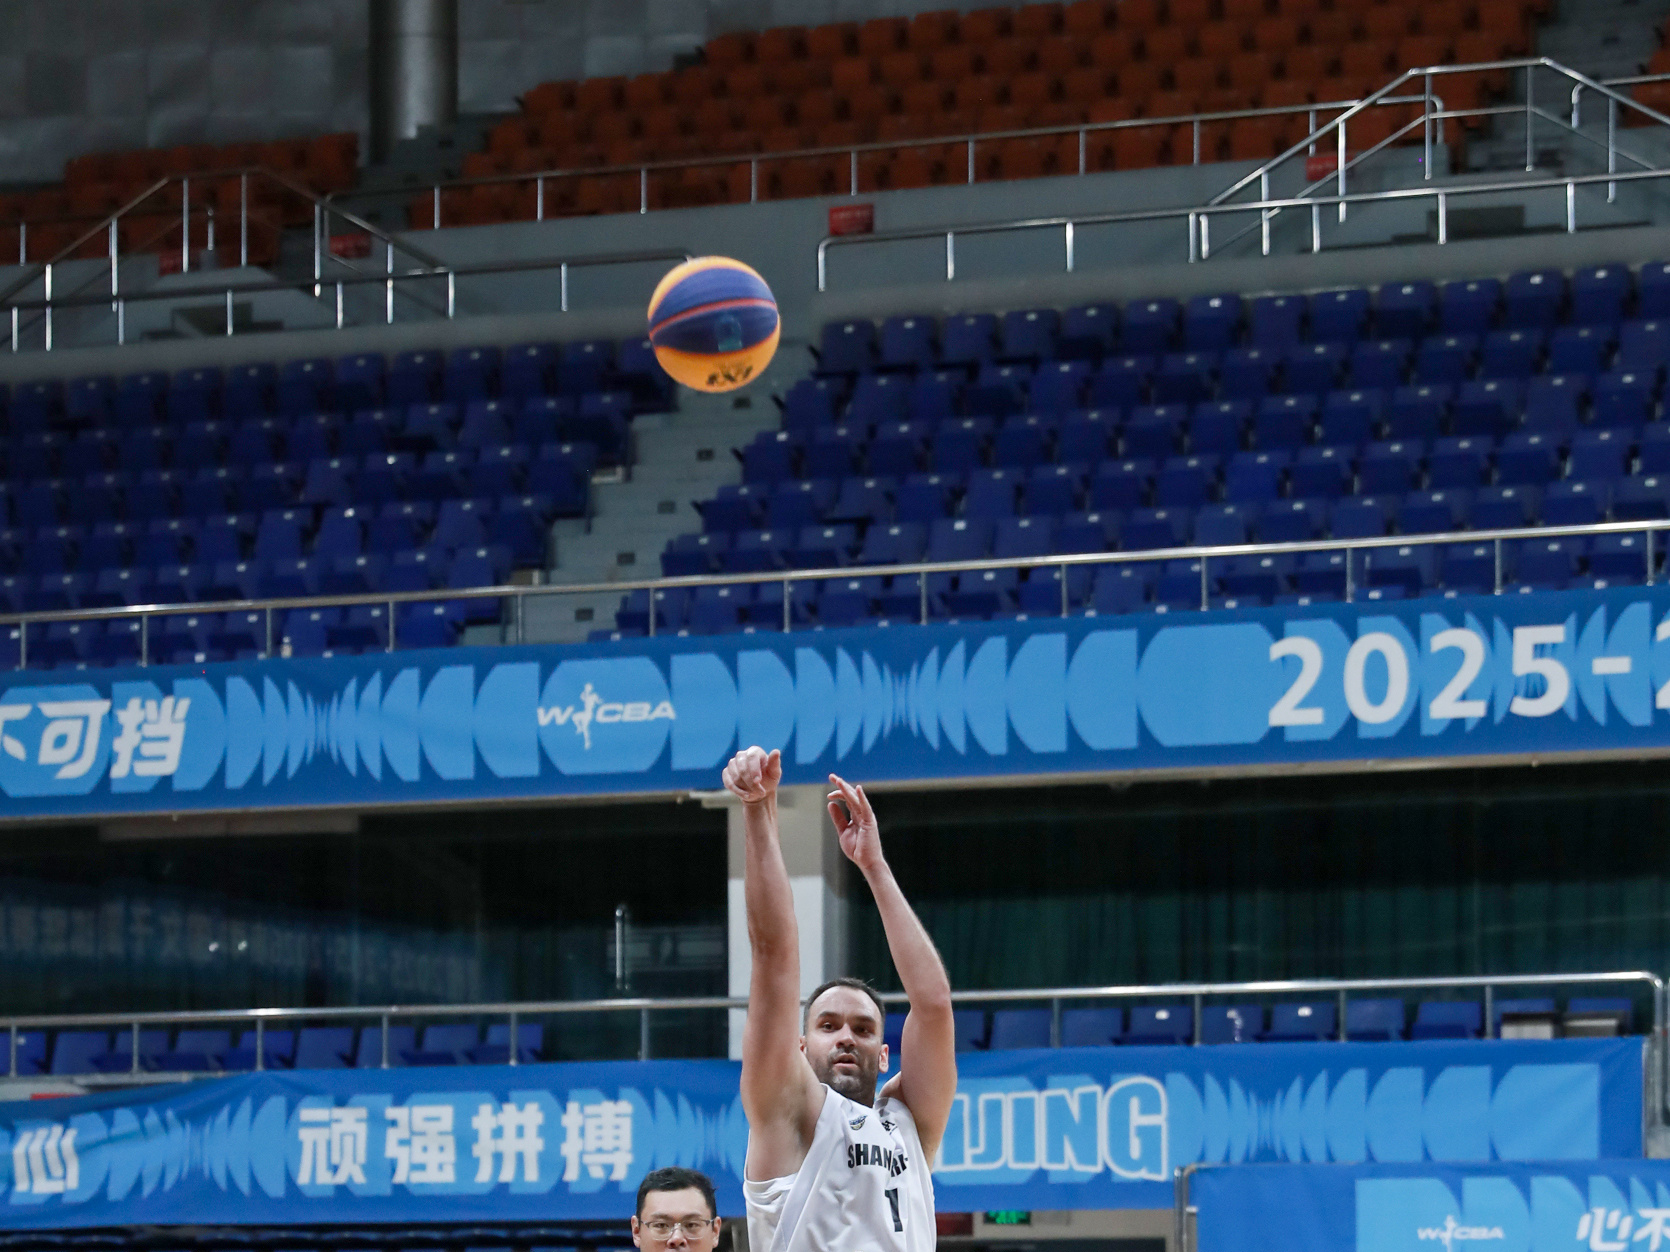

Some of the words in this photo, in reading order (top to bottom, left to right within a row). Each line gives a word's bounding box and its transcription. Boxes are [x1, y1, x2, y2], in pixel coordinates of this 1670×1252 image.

[1268, 624, 1670, 728] 2025-
[299, 1100, 634, 1185] 顽强拼搏
[931, 1075, 1168, 1182] IJING
[884, 1187, 904, 1233] 1
